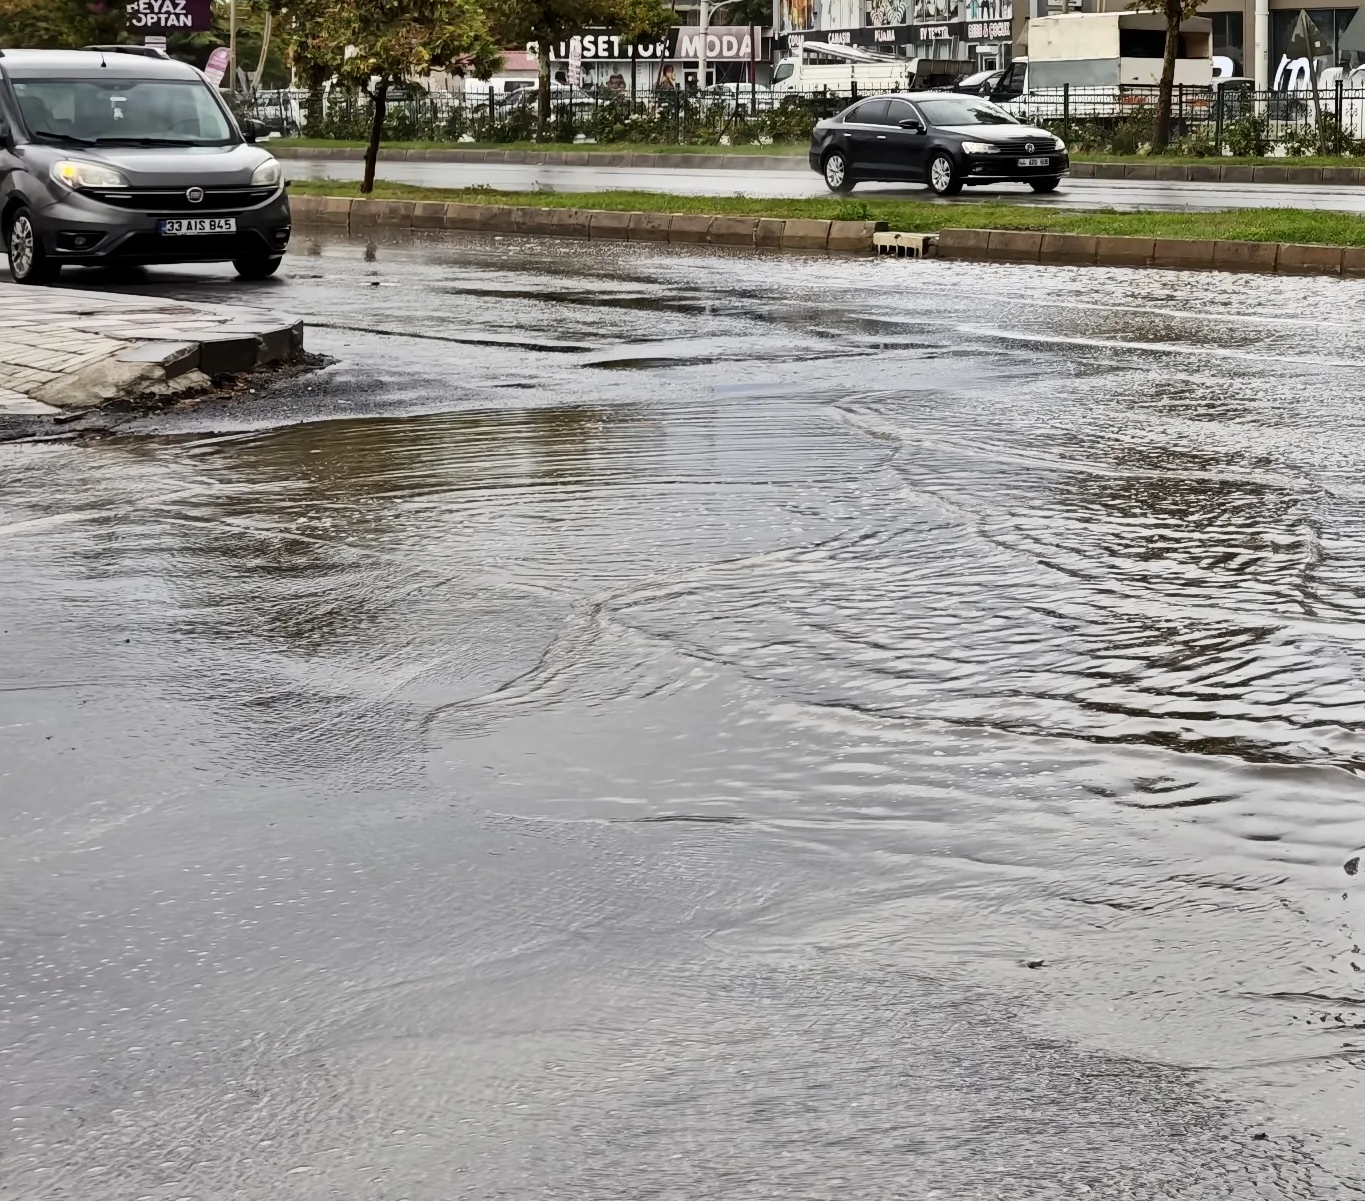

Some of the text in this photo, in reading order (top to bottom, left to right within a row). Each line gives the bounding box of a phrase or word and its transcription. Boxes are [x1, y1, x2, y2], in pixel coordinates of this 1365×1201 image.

[126, 14, 192, 26] OPTAN
[681, 35, 752, 57] MODA
[167, 219, 232, 231] 33 AIS 845
